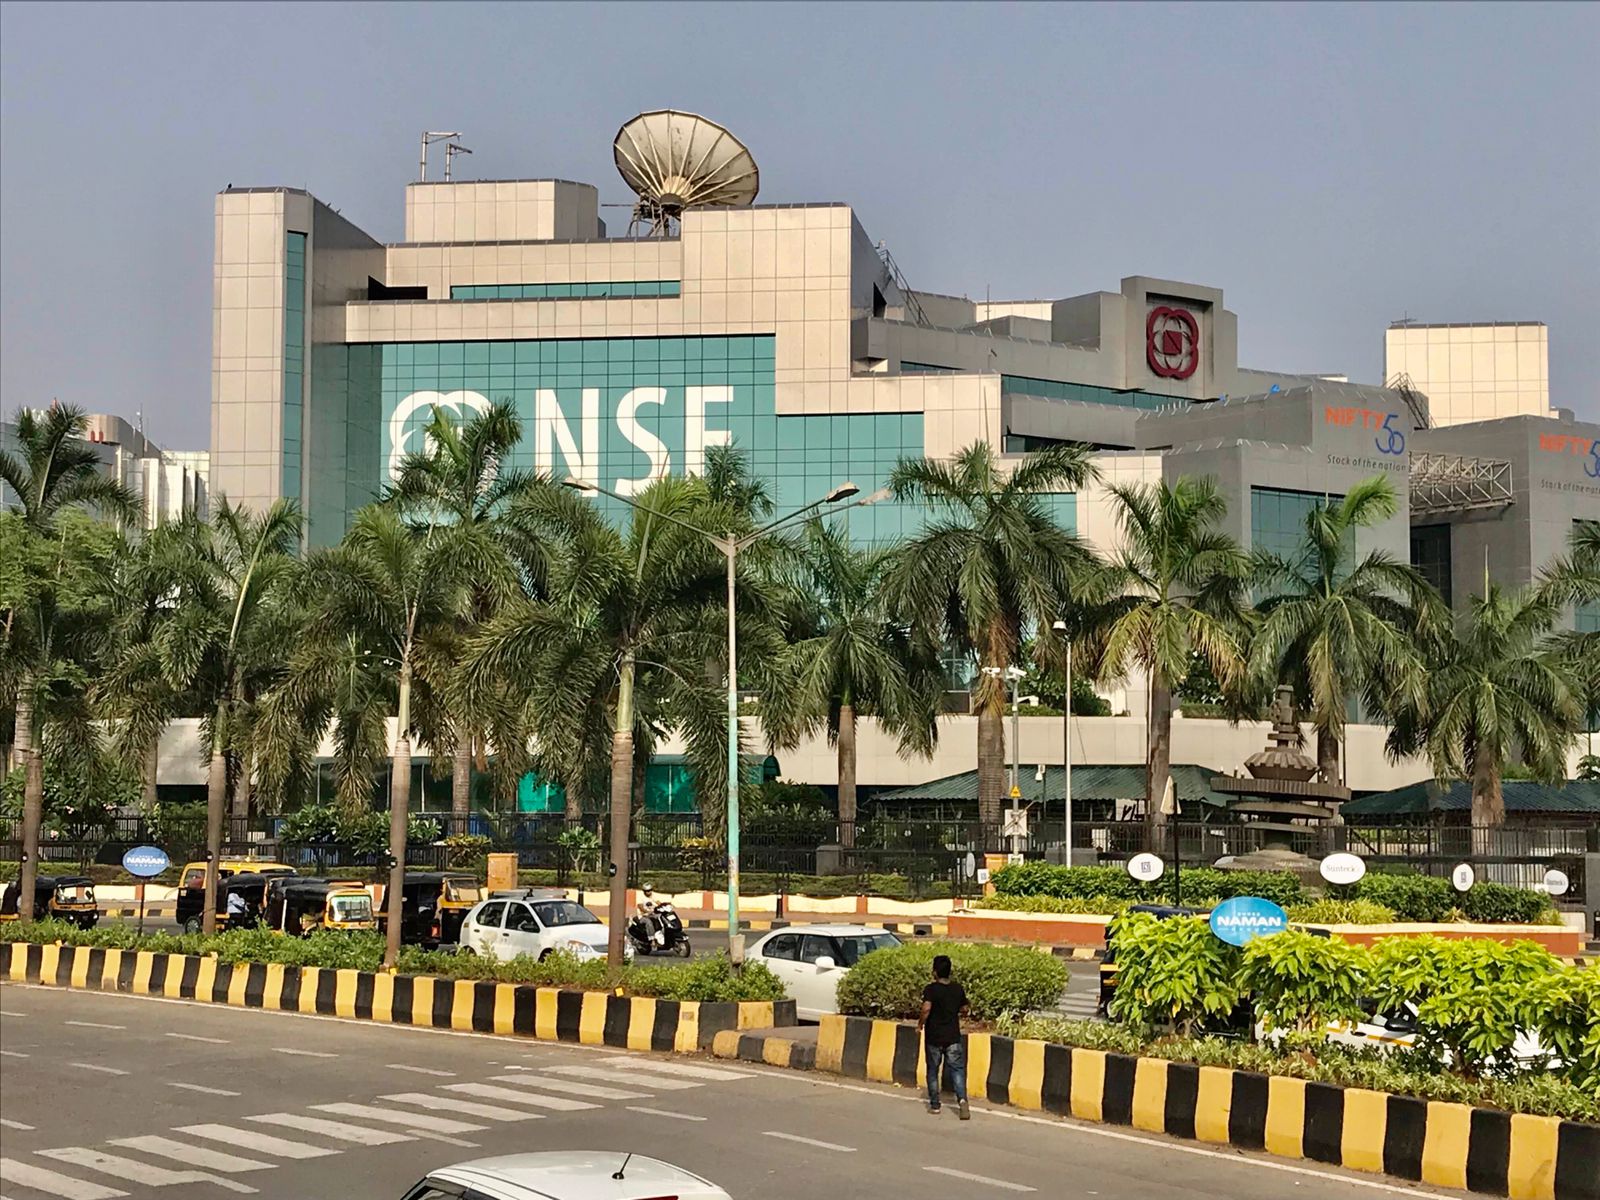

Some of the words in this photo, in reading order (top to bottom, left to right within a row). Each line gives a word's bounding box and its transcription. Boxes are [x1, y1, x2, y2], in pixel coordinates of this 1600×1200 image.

[535, 386, 734, 497] NSE
[1325, 406, 1386, 431] NIFTY
[1375, 413, 1405, 455] 50
[1327, 454, 1350, 465] Stock
[1352, 457, 1361, 467] of
[1362, 458, 1377, 469] the
[1378, 462, 1406, 472] nation
[1217, 916, 1282, 926] NAMAN
